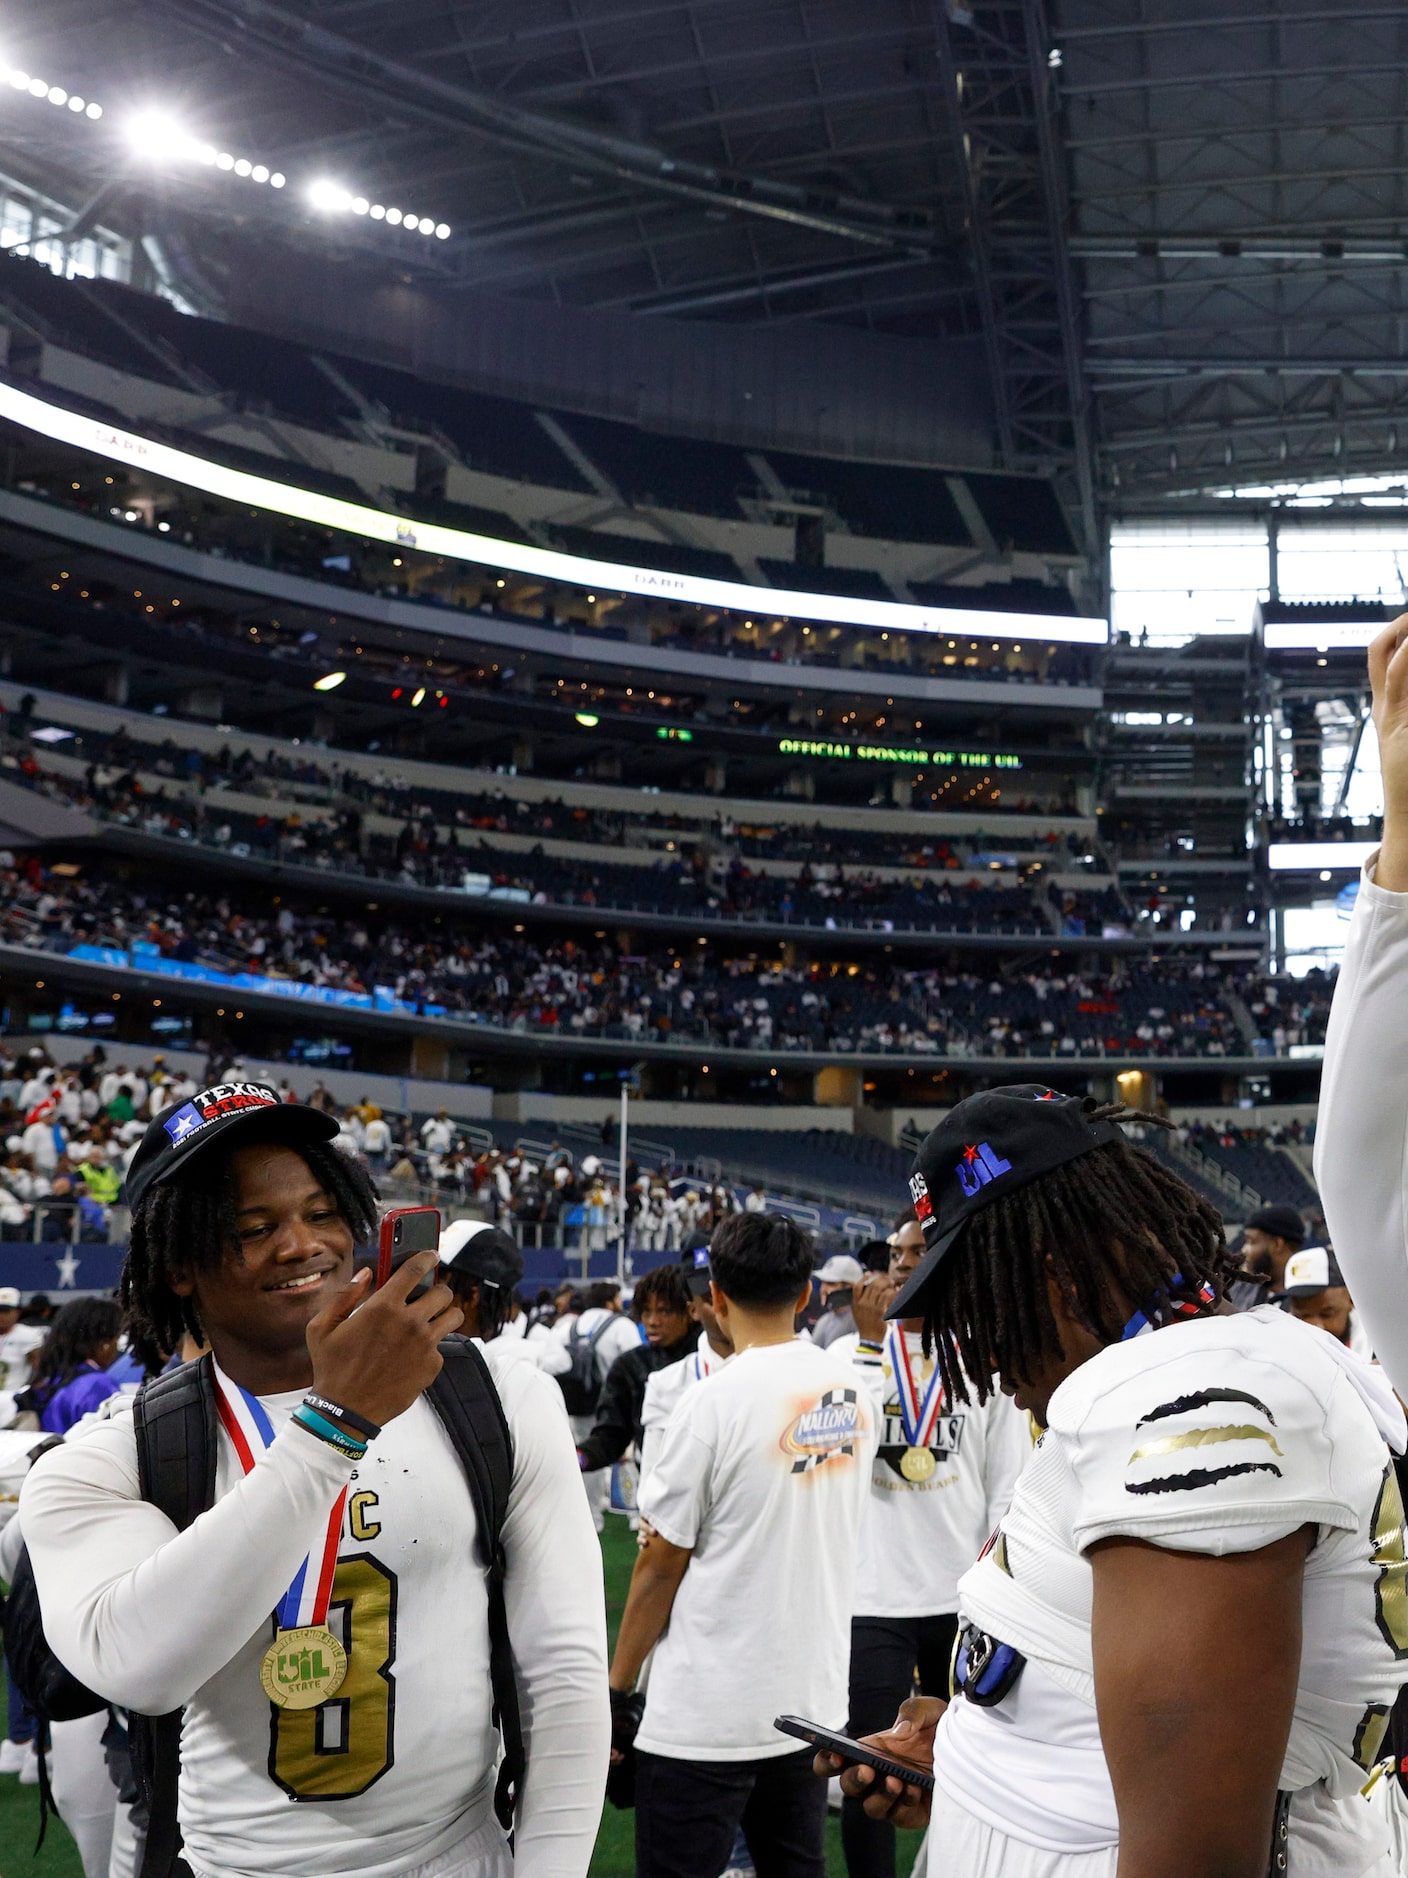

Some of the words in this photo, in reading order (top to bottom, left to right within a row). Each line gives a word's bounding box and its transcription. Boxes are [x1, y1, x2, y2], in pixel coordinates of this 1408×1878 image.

[779, 738, 850, 758] OFFICIAL
[856, 745, 929, 765] SPONSOR
[932, 751, 955, 766] OF
[958, 752, 992, 767] THE
[994, 754, 1024, 769] UIL
[193, 1082, 278, 1109] TEXAS
[186, 1115, 222, 1139] FOOTBALL
[220, 1106, 246, 1118] STATE
[954, 1142, 1013, 1198] UIL
[318, 1398, 345, 1418] Black
[797, 1406, 858, 1437] MALLORY
[918, 1474, 960, 1492] BEARS
[277, 1648, 331, 1684] UIL
[288, 1680, 322, 1693] STATE
